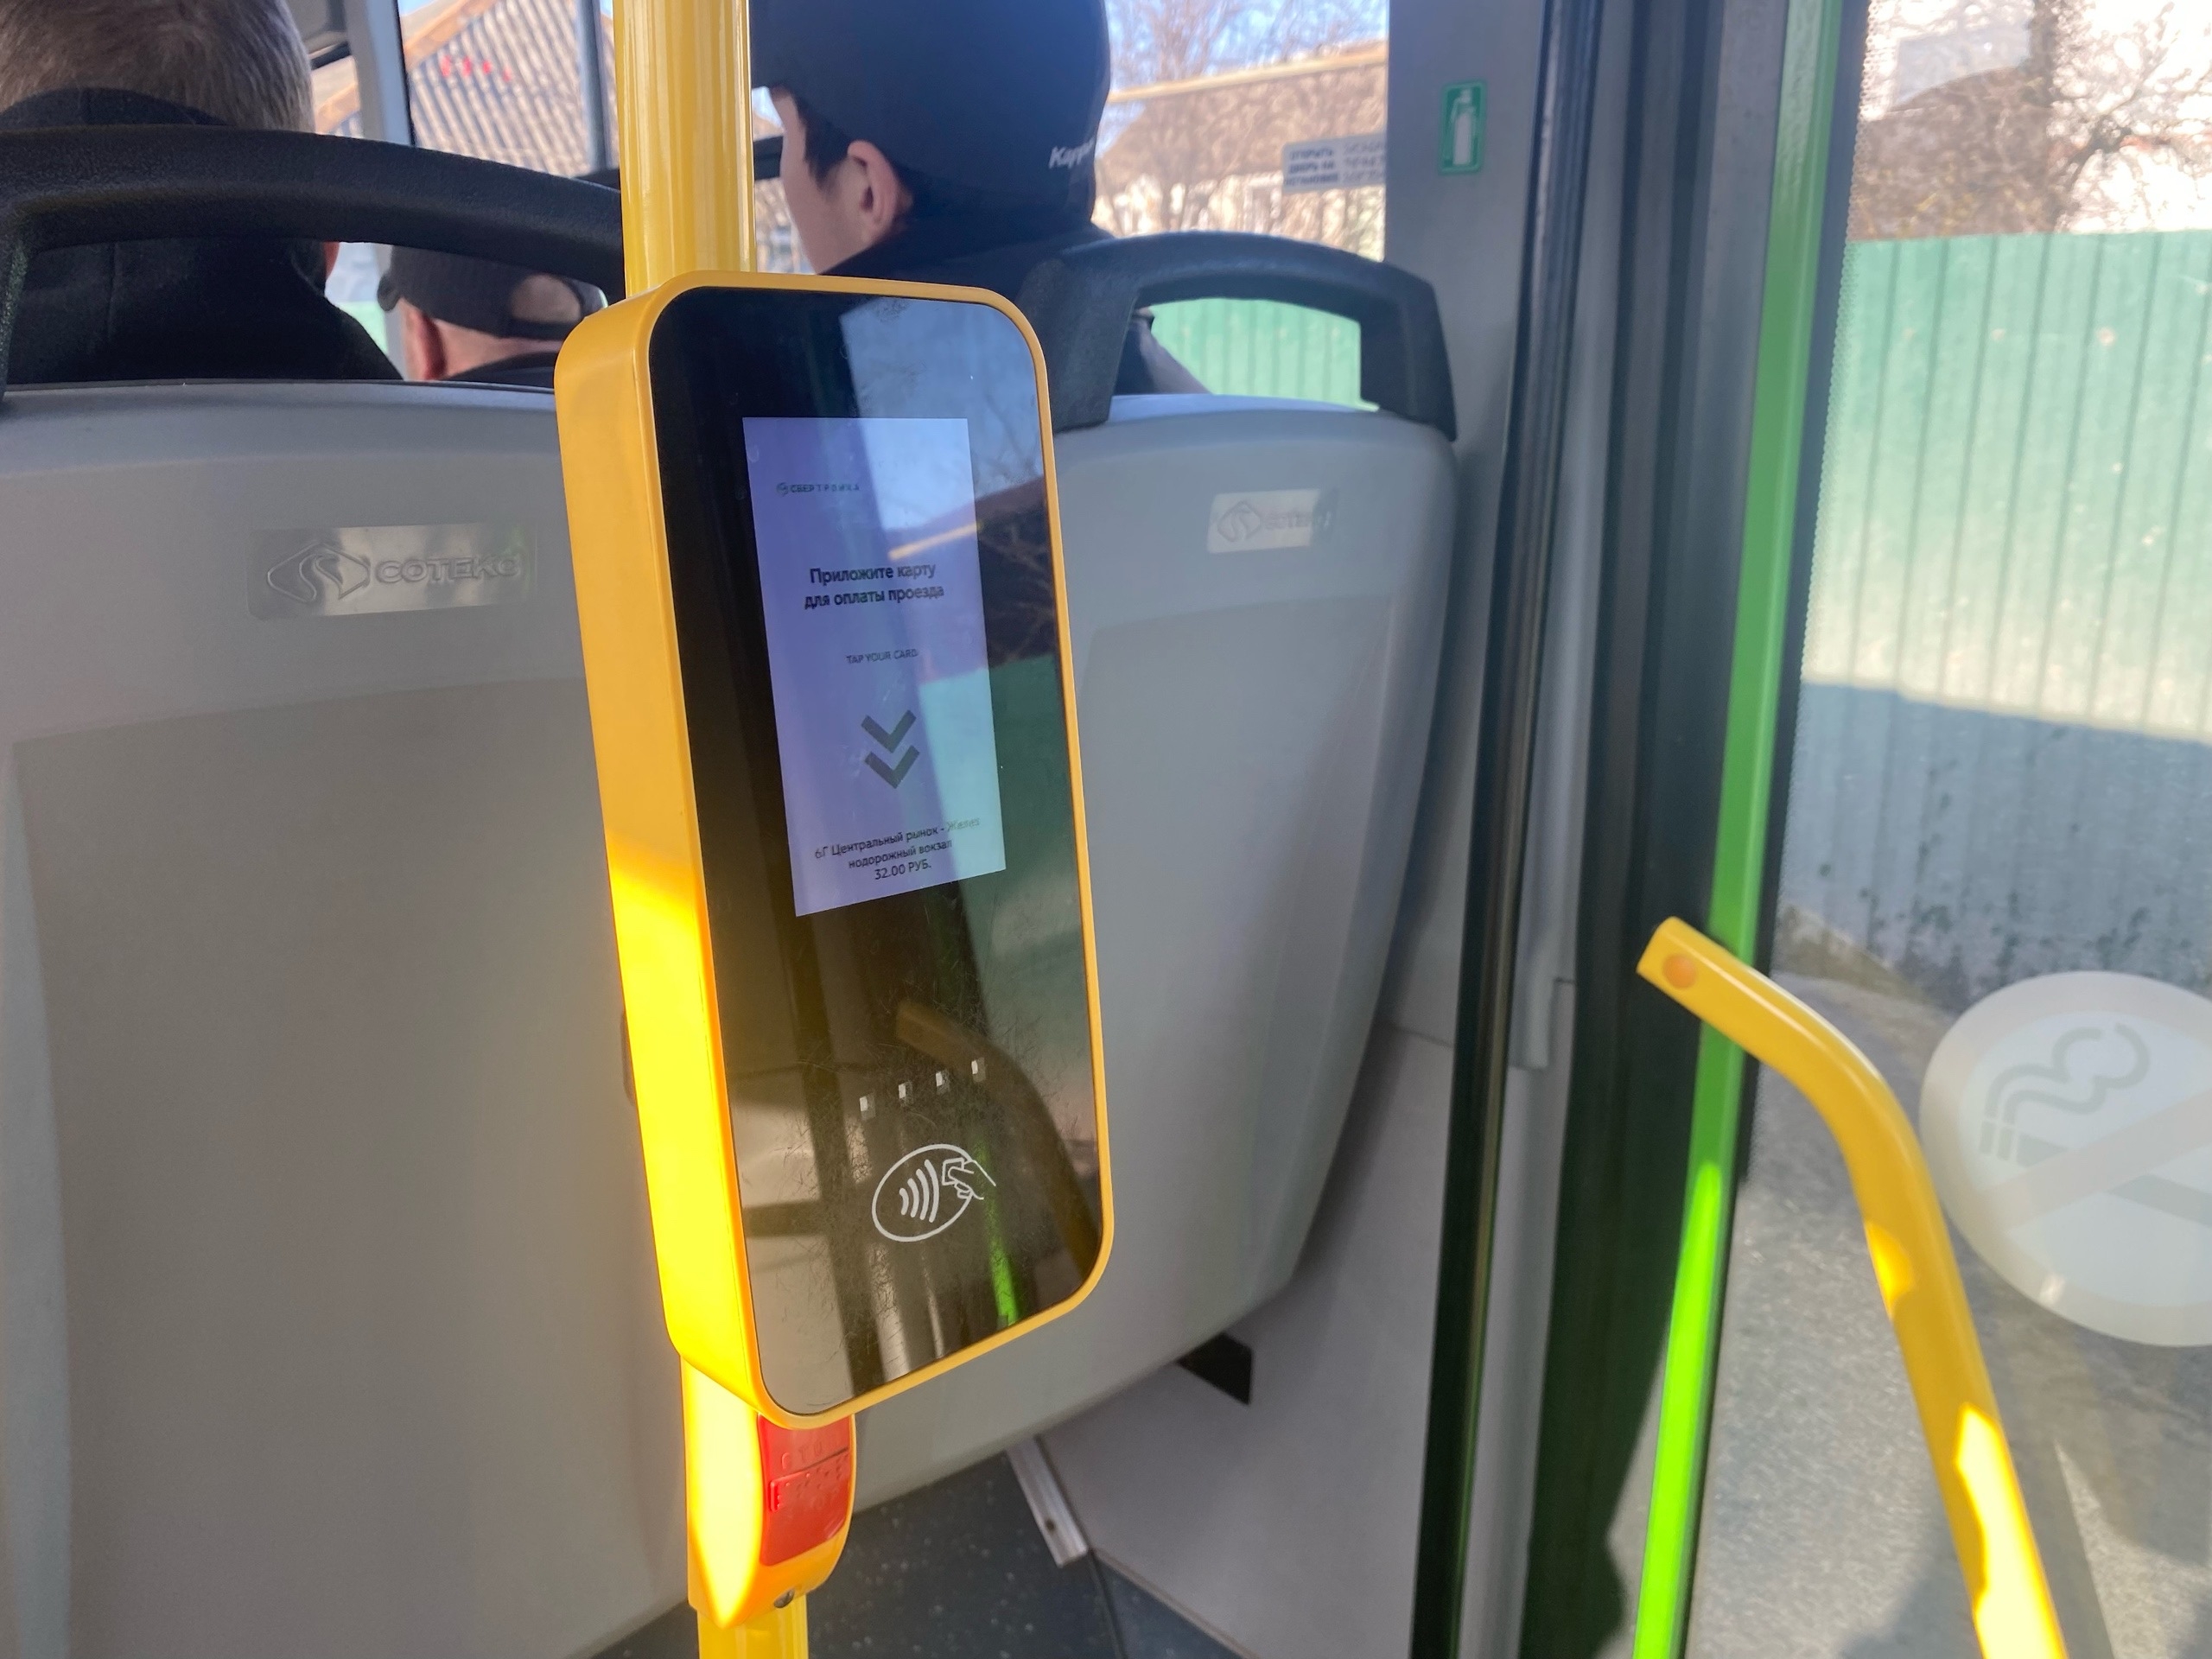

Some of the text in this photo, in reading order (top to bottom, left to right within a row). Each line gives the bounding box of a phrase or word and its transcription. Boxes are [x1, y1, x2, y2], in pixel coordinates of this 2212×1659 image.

[810, 563, 936, 586] Приложите карту
[804, 585, 944, 610] для оплаты проезда
[846, 648, 918, 664] TAP YOUR CARD
[832, 832, 903, 856] Центральный
[906, 827, 938, 842] рынок
[849, 839, 952, 868] нодорожный вокзал
[874, 858, 931, 880] 32.00 РУБ.
